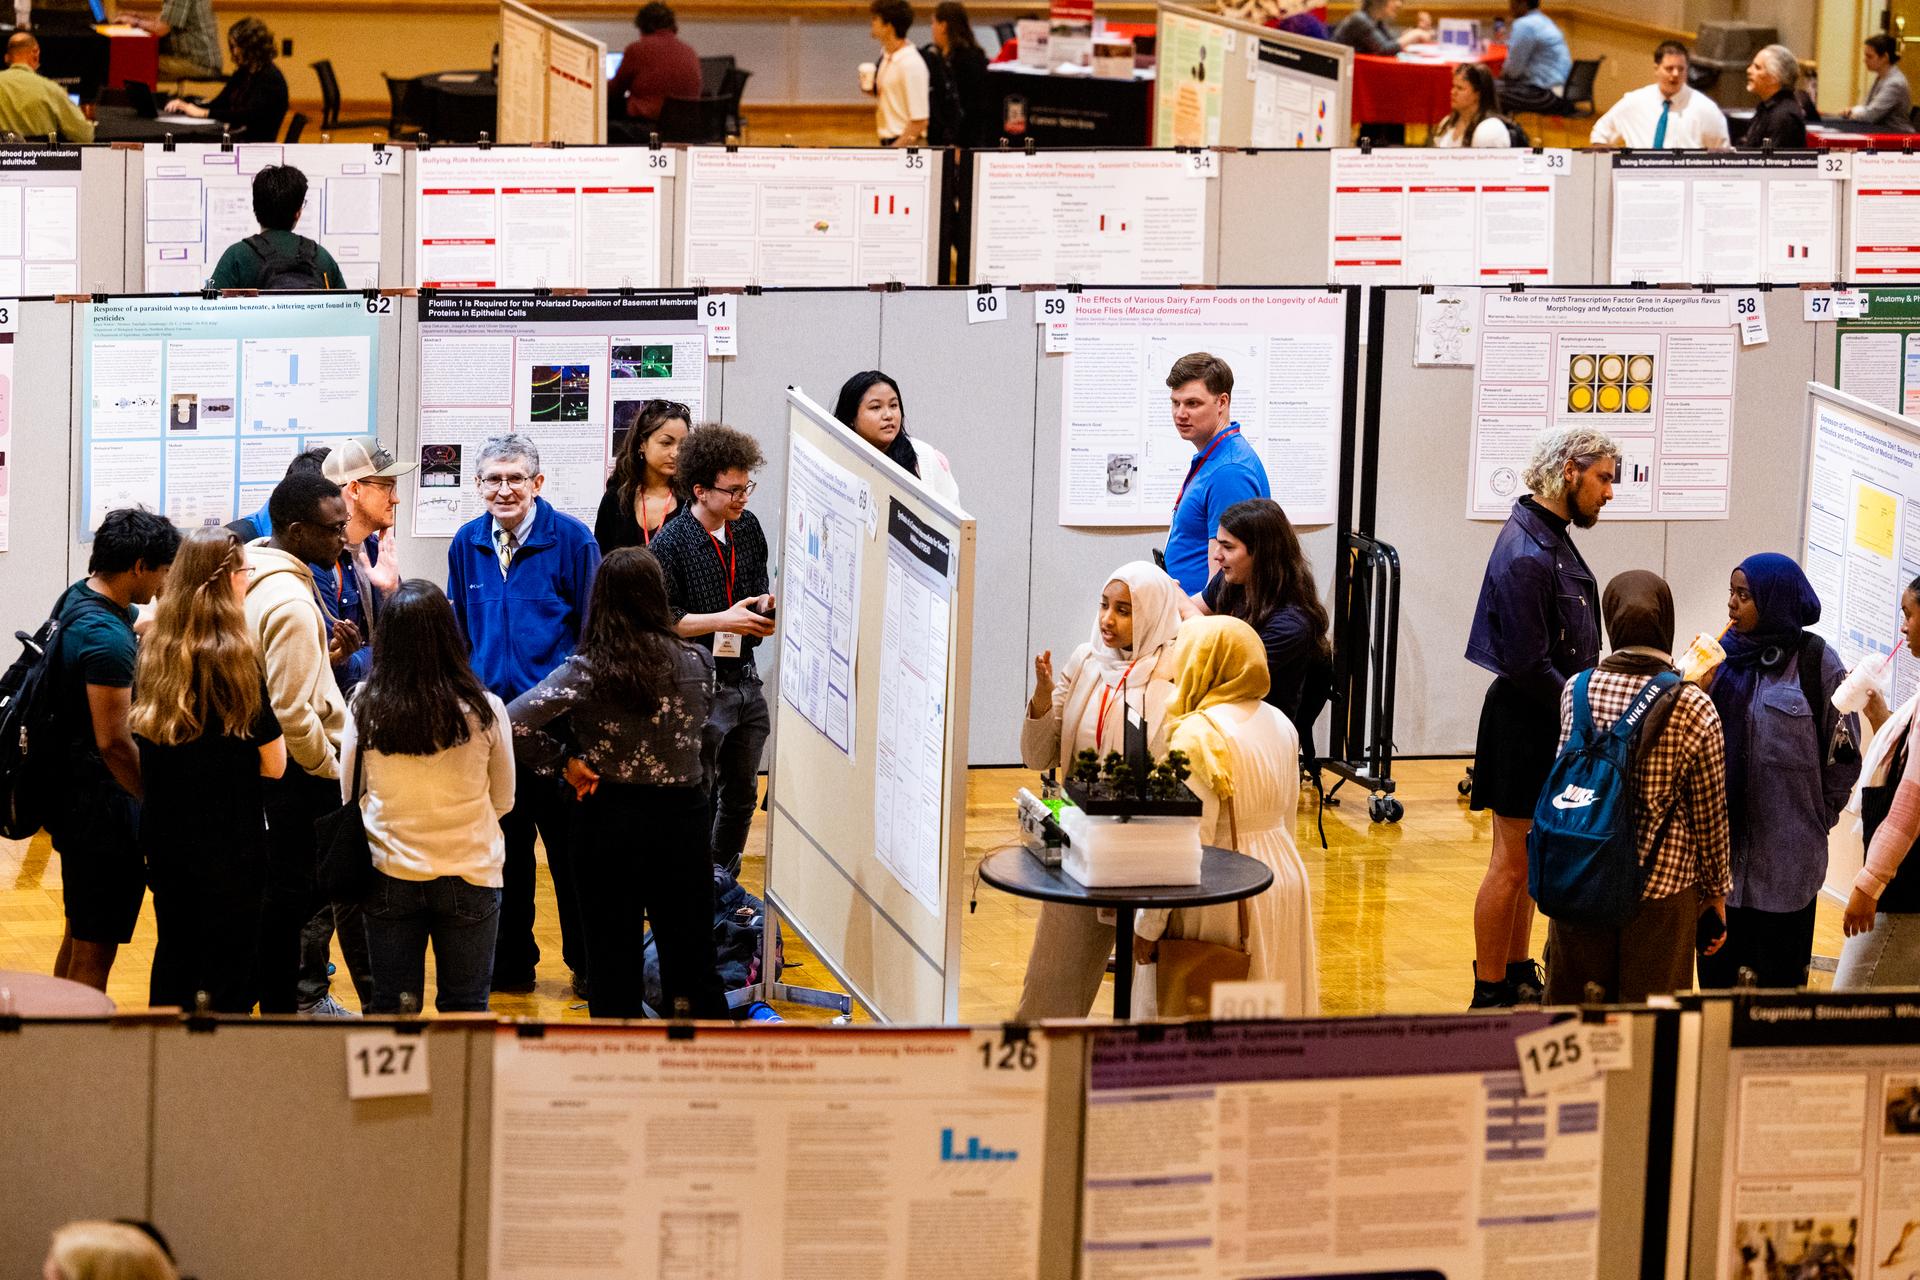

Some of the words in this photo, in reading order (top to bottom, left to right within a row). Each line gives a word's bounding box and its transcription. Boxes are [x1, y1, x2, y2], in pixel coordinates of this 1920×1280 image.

[24, 150, 78, 160] polyvictimization
[374, 152, 393, 166] 37
[649, 155, 667, 168] 36
[906, 156, 923, 168] 35
[1547, 155, 1563, 168] 33
[1194, 157, 1211, 170] 34
[1826, 159, 1843, 171] 32
[367, 298, 390, 313] 62
[474, 300, 506, 308] Required
[572, 299, 611, 308] Deposition
[977, 297, 997, 312] 60
[1045, 299, 1065, 314] 59
[1167, 296, 1187, 306] Dairy
[1190, 296, 1210, 304] Farm
[1213, 296, 1237, 304] Foods
[1252, 296, 1264, 304] the
[1267, 296, 1305, 306] Longevity
[1308, 296, 1316, 304] of
[1318, 296, 1338, 304] Adult
[1568, 296, 1611, 304] Transcription
[1663, 298, 1699, 306] Aspergillus
[1738, 298, 1756, 314] 58
[1812, 298, 1830, 312] 57
[0, 308, 8, 323] 3
[471, 310, 505, 318] Epithelial
[707, 302, 725, 316] 61
[1126, 306, 1154, 315] (Musca
[1157, 307, 1201, 315] domestica)
[1546, 305, 1586, 313] Morphology
[1626, 701, 1647, 726] NIKE
[1645, 684, 1661, 703] AIR
[1562, 784, 1595, 802] NIKE
[355, 1044, 416, 1077] 127
[979, 1041, 1037, 1070] 126
[1525, 1033, 1582, 1075] 125
